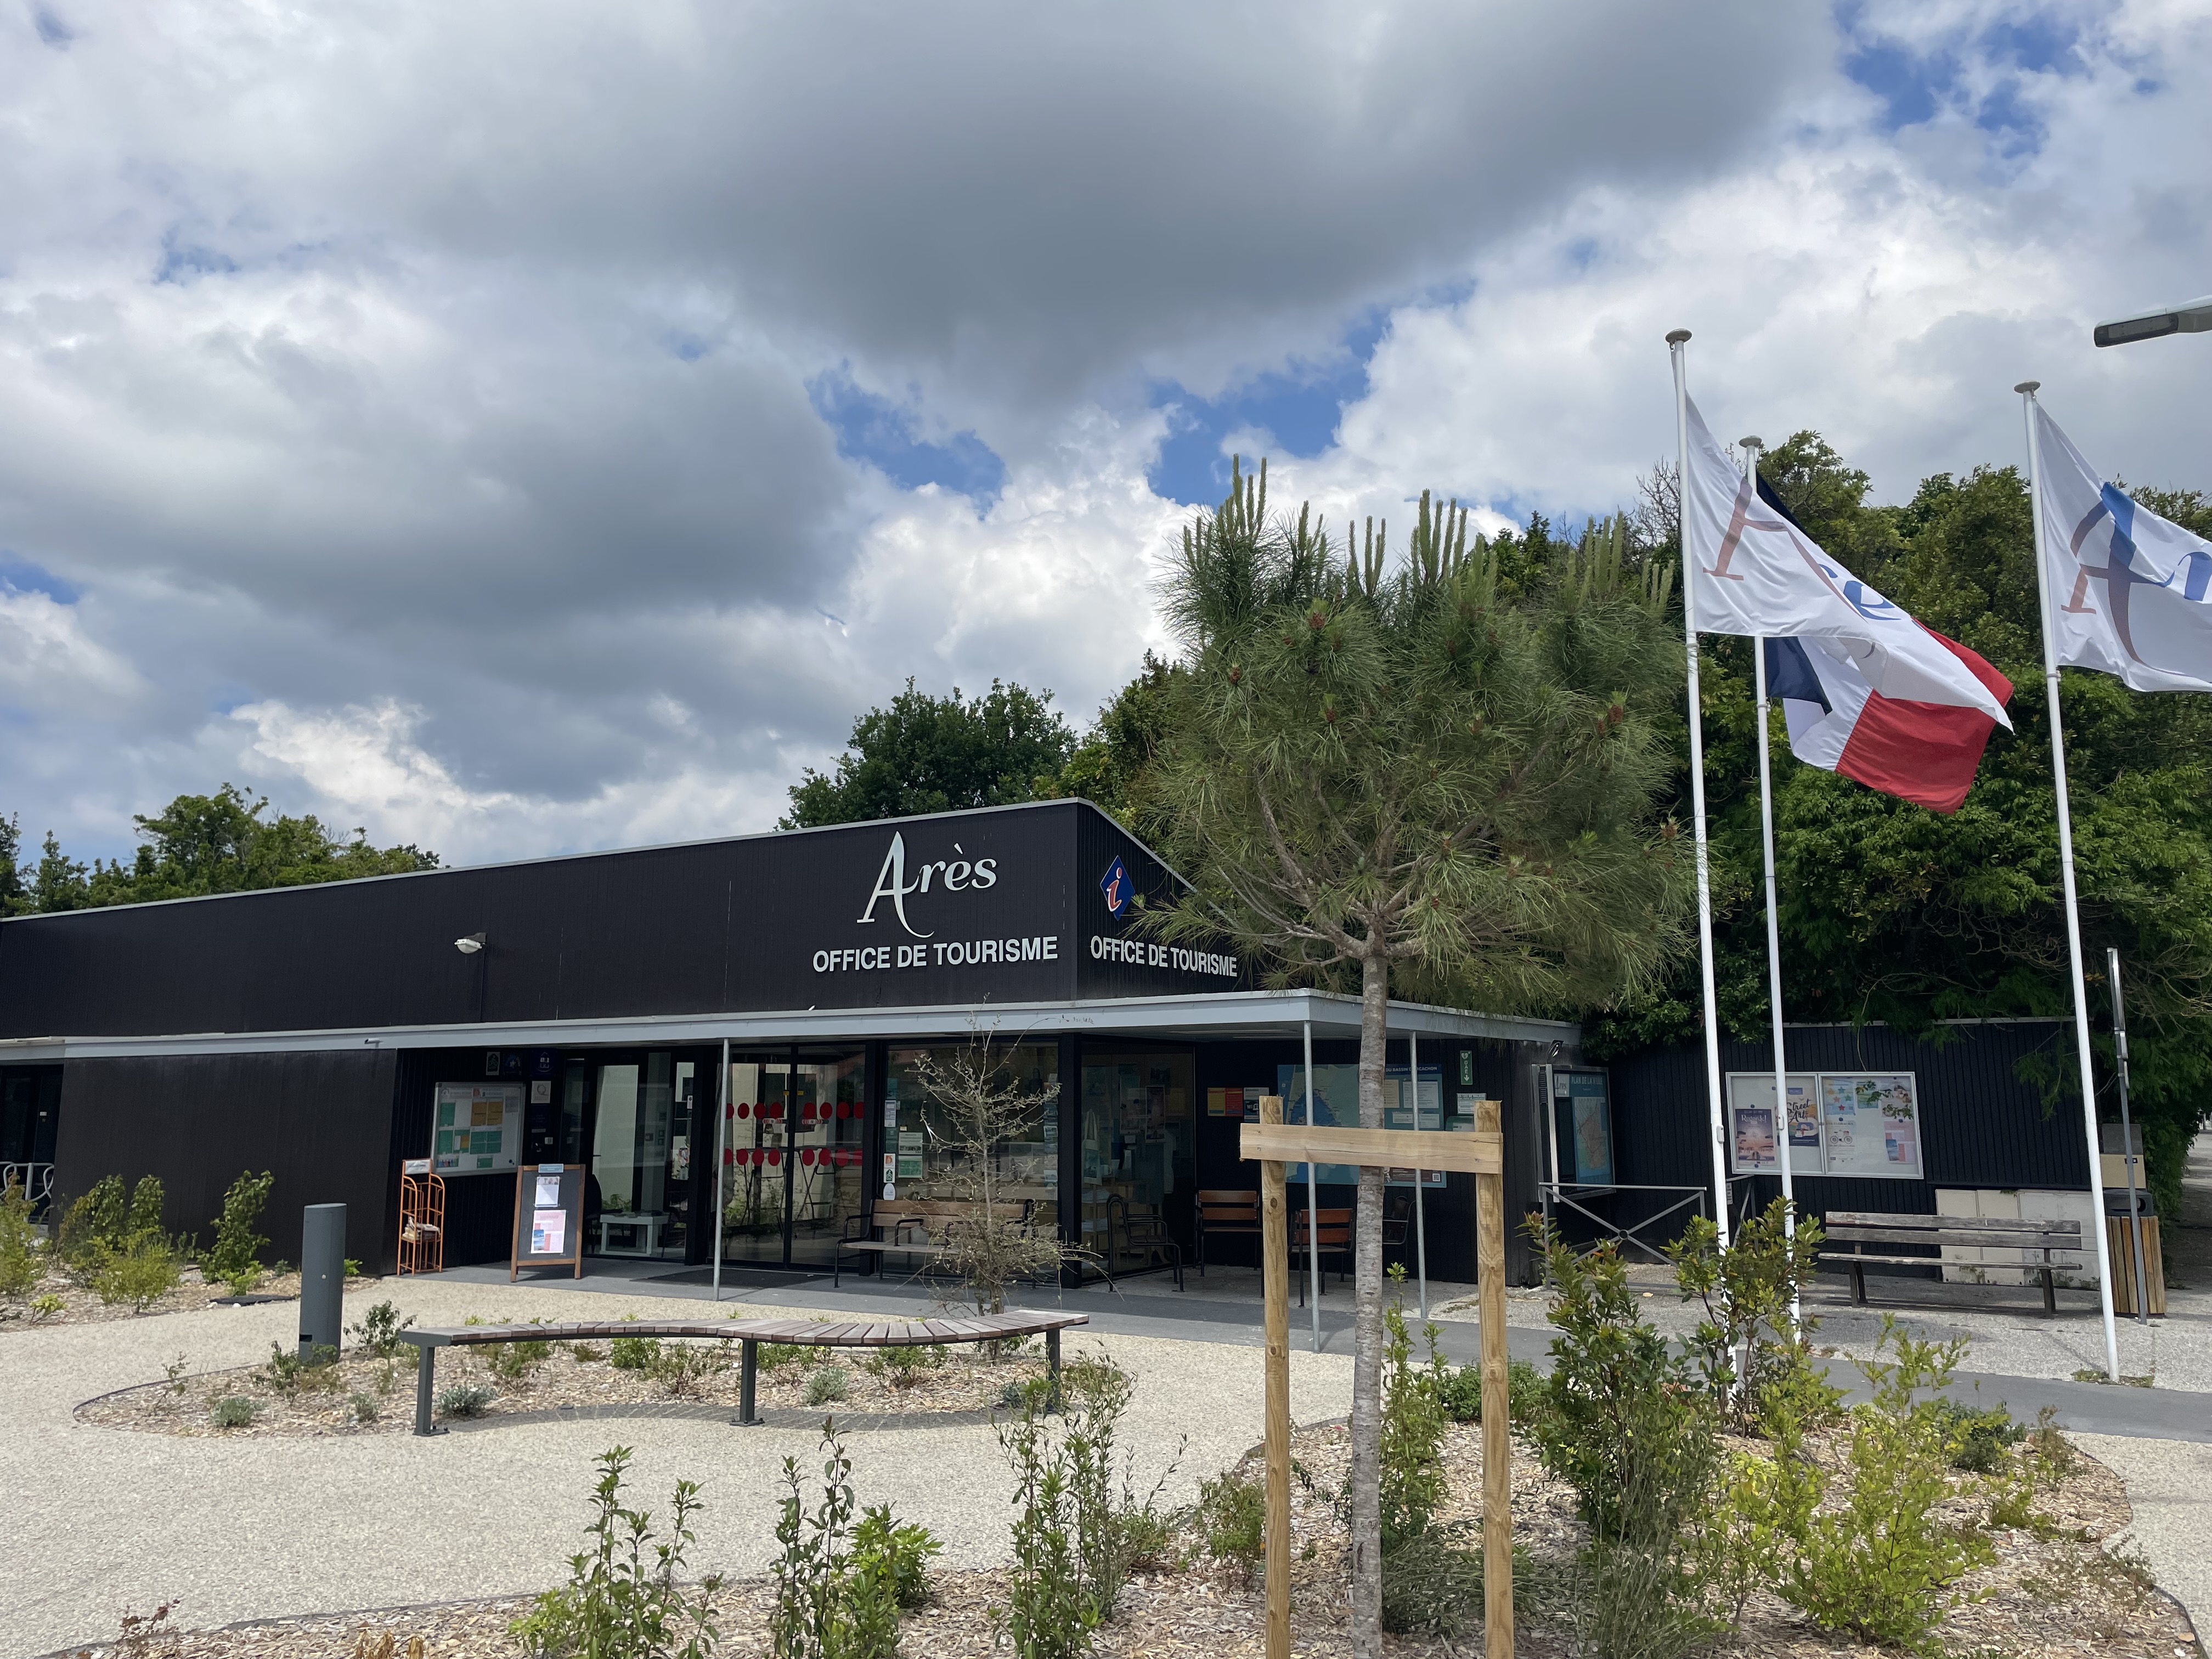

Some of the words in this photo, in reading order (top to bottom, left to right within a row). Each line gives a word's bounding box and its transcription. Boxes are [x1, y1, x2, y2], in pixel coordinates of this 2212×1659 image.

[856, 831, 997, 938] Arès
[812, 946, 890, 973] OFFICE
[897, 945, 927, 968] DE
[933, 936, 1058, 966] TOURISME
[1091, 935, 1145, 964] OFFICE
[1148, 944, 1168, 968] DE
[1170, 947, 1238, 977] TOURISME
